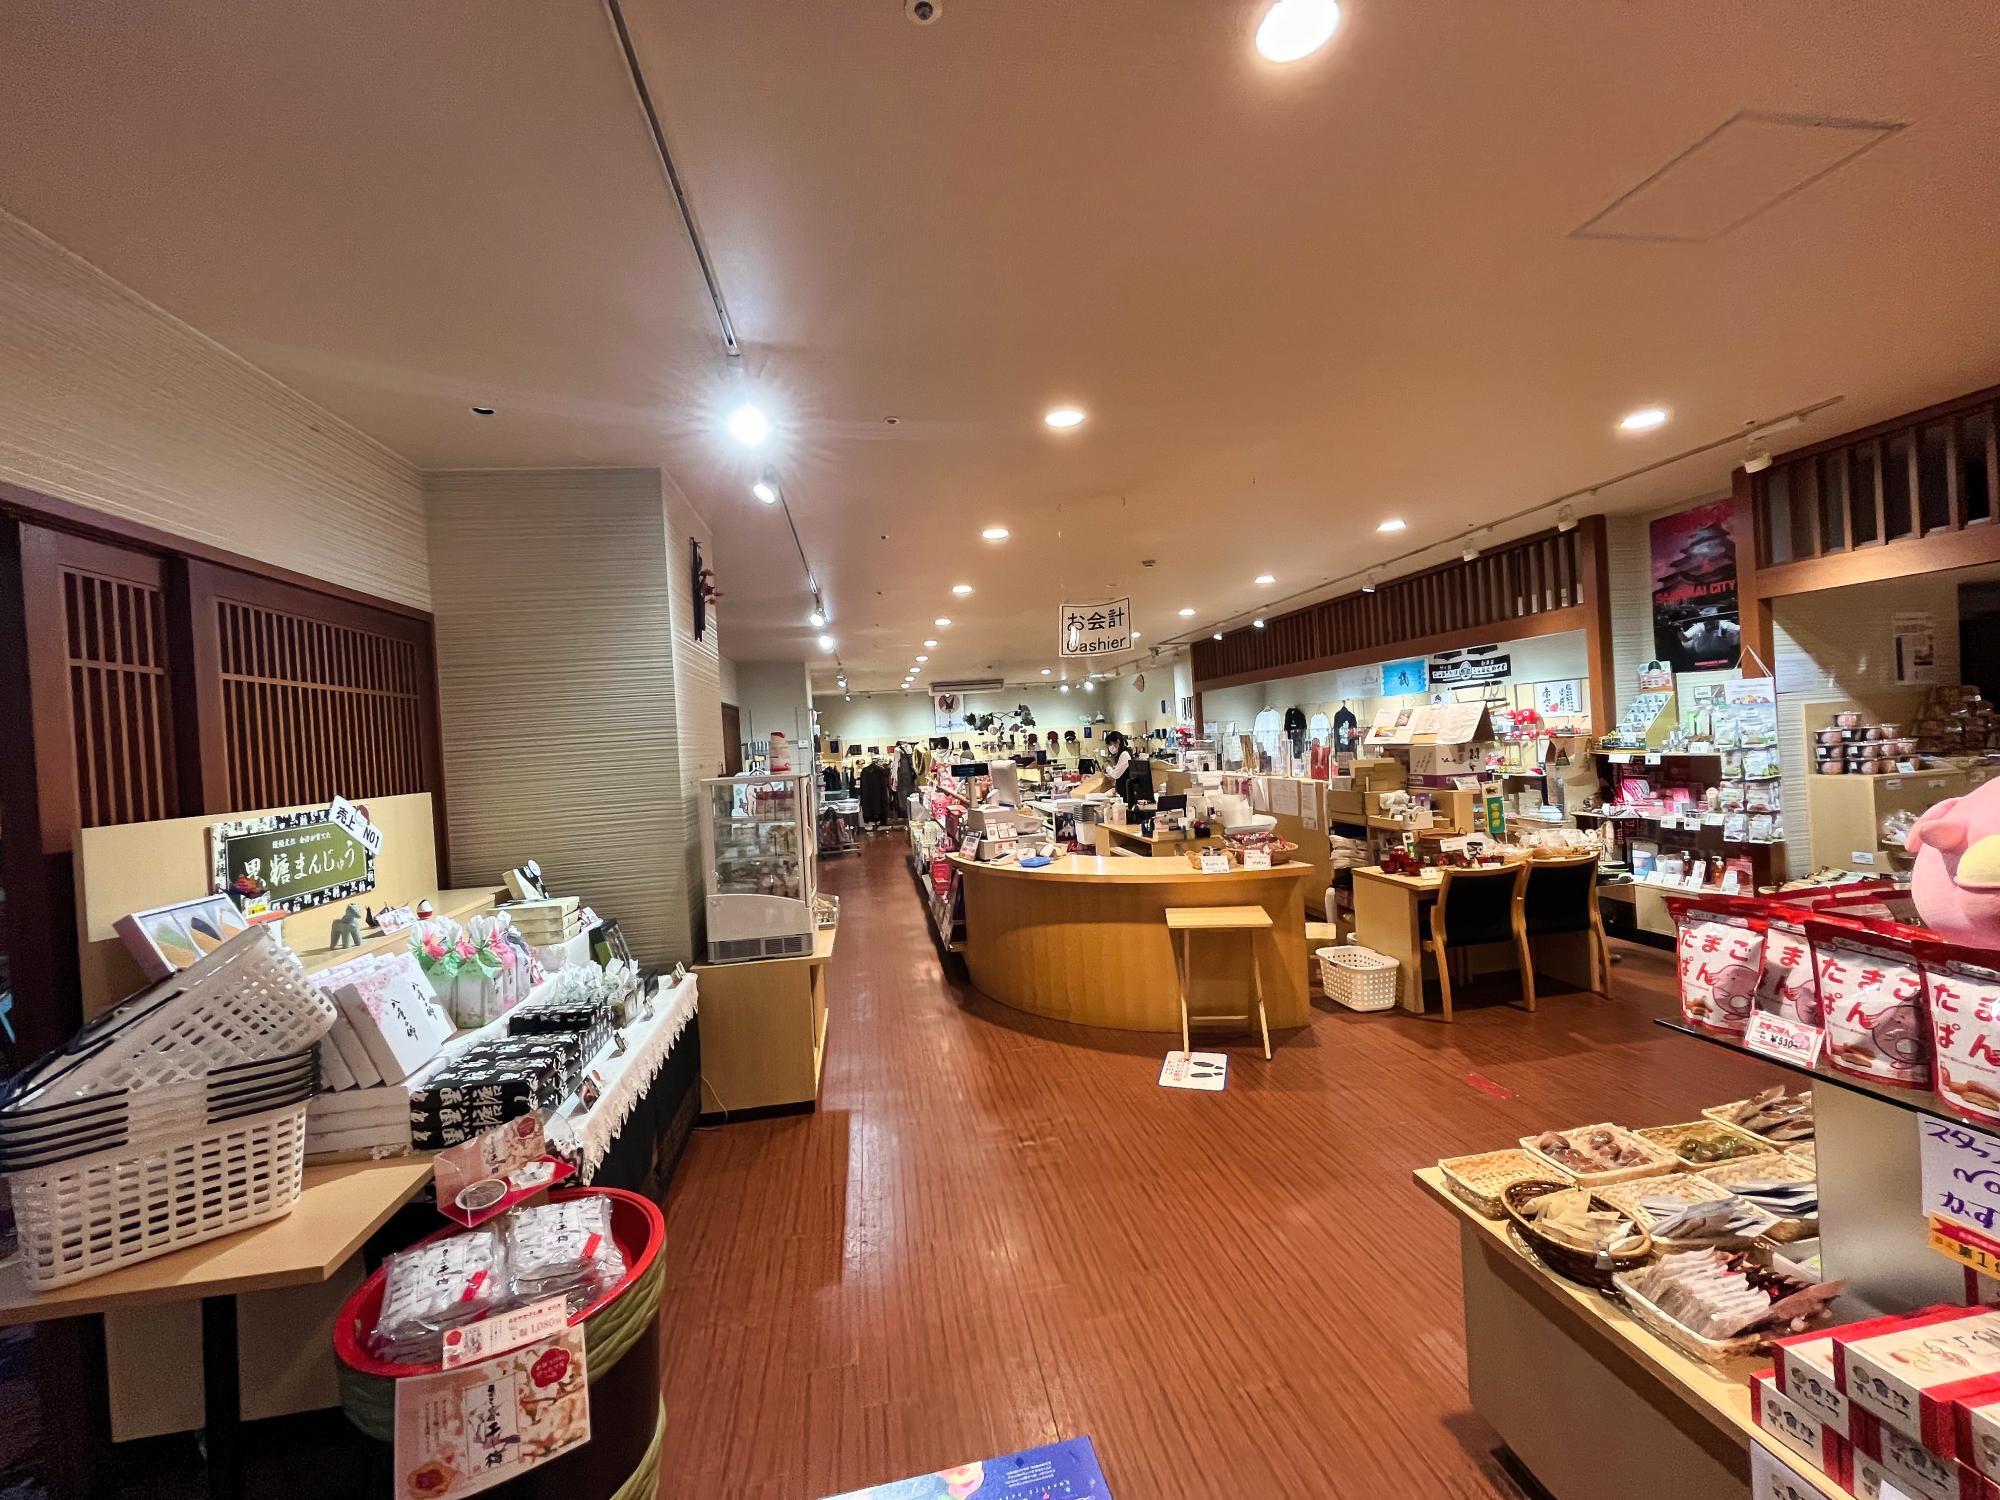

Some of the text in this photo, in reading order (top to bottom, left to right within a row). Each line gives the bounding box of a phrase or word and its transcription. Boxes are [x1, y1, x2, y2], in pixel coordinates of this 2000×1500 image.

[1710, 580, 1736, 594] CITY
[1067, 607, 1125, 631] お会計
[1067, 636, 1126, 653] Cashier
[336, 806, 380, 848] 売上 NO1
[244, 840, 355, 888] 黒糖まんじゅう
[1681, 928, 1750, 962] たまご
[1821, 957, 1921, 1001] たまご
[1823, 992, 1875, 1030] ぱん
